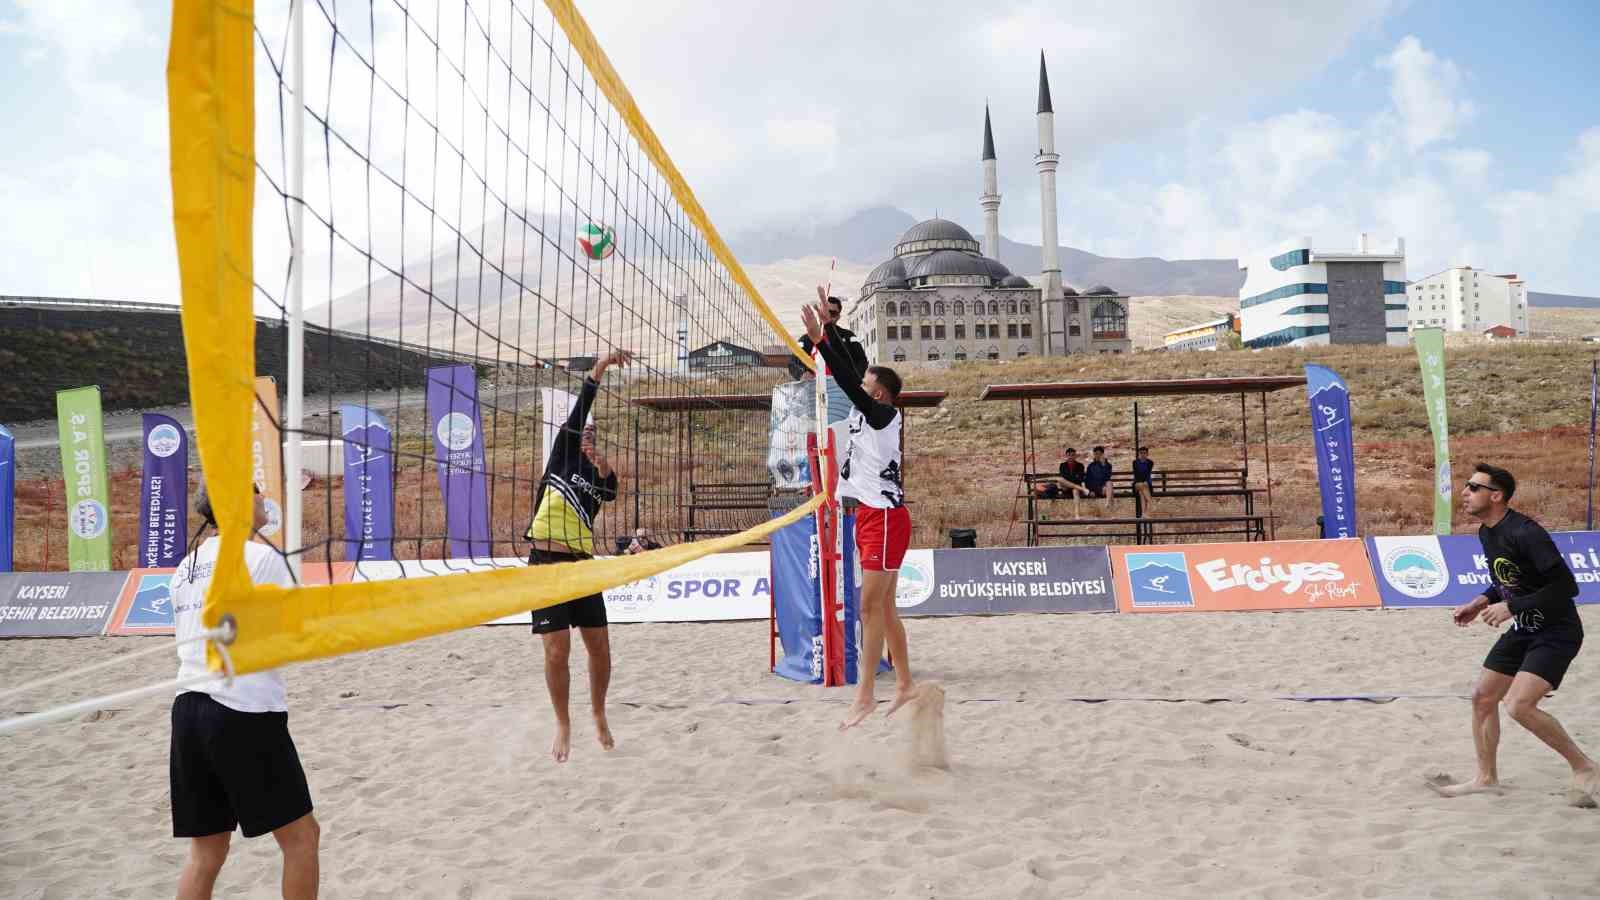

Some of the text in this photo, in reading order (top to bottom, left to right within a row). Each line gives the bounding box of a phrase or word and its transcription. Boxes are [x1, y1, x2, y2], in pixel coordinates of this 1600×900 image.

[992, 558, 1048, 576] KAYSERİ
[1195, 557, 1344, 594] Erciyes
[16, 582, 71, 599] KAYSERİ
[607, 594, 633, 602] SPOR
[667, 578, 741, 599] SPOR
[939, 576, 1106, 600] BÜYÜKŞEHİR BELEDİYESİ
[38, 600, 110, 620] BELEDİYESİ
